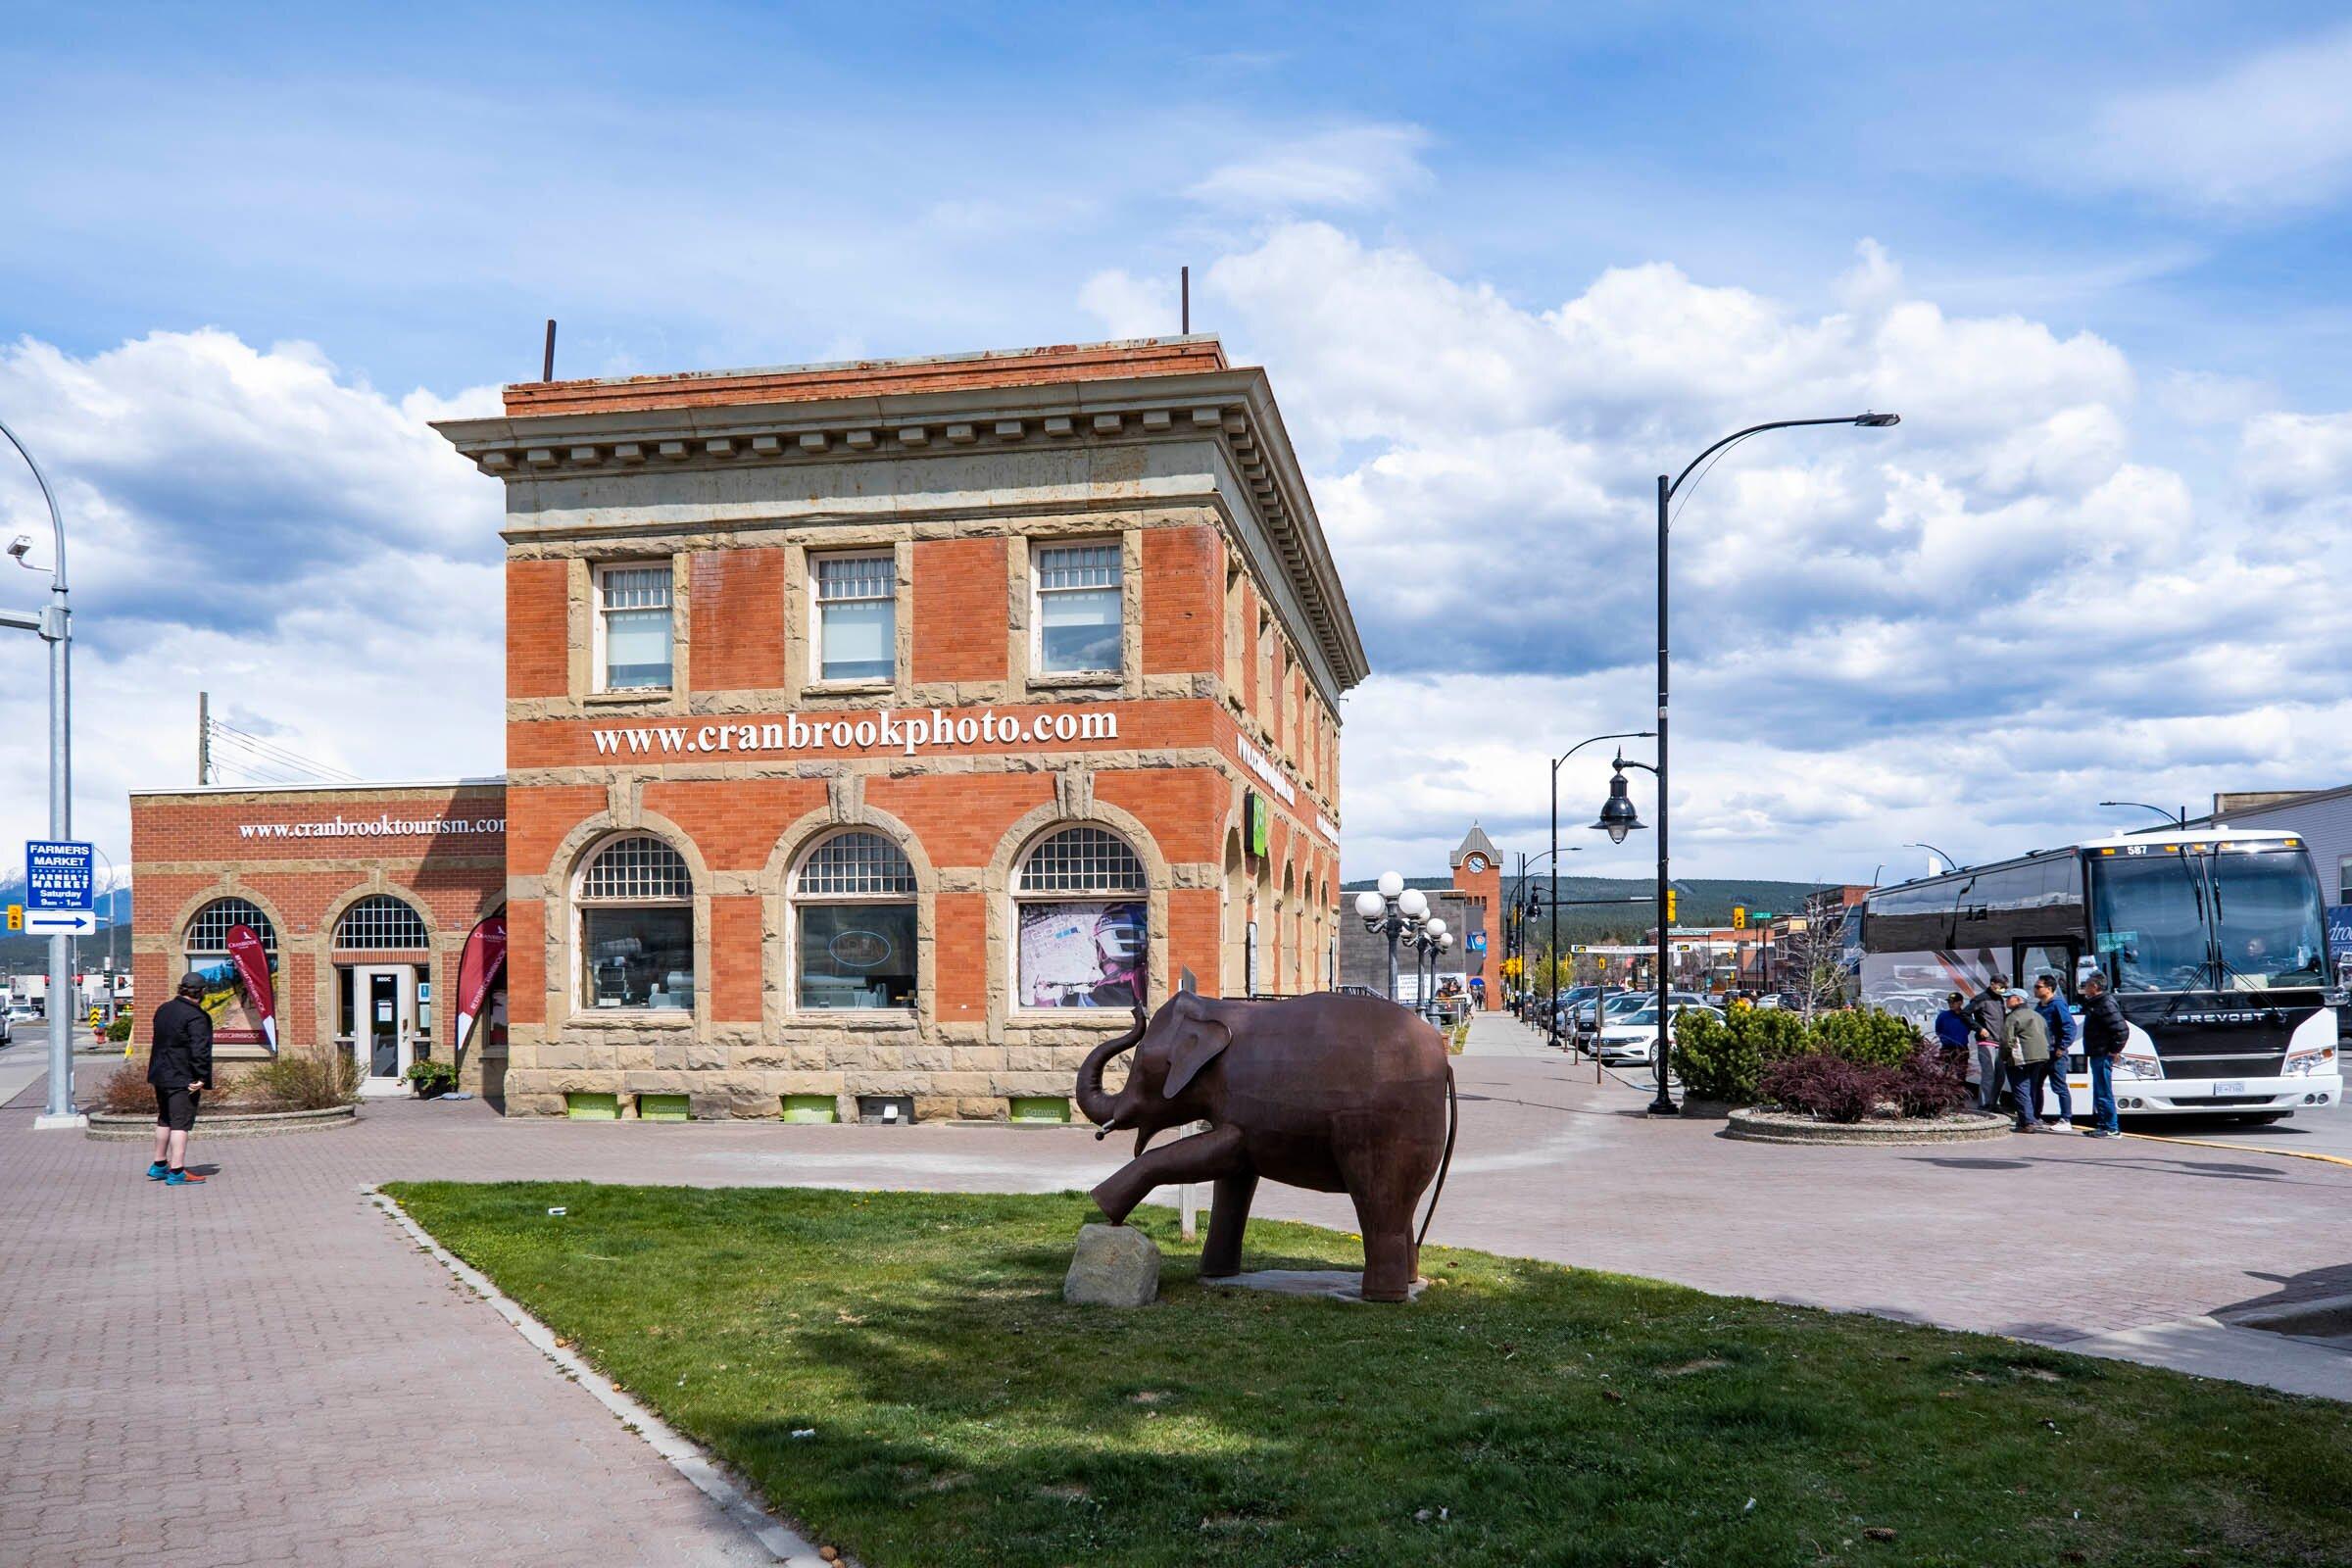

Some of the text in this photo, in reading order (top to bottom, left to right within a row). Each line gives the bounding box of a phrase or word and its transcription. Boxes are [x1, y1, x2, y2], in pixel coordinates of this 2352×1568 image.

[592, 709, 1118, 755] www.cranbrookphoto.com
[30, 845, 89, 855] FARMERS
[2127, 845, 2149, 856] 587
[34, 857, 85, 866] MARKET
[31, 880, 89, 889] MARKET
[40, 889, 81, 900] Saturday
[2177, 1012, 2266, 1024] PREVOST
[649, 1103, 688, 1112] Cameras
[1023, 1106, 1059, 1116] Canvas
